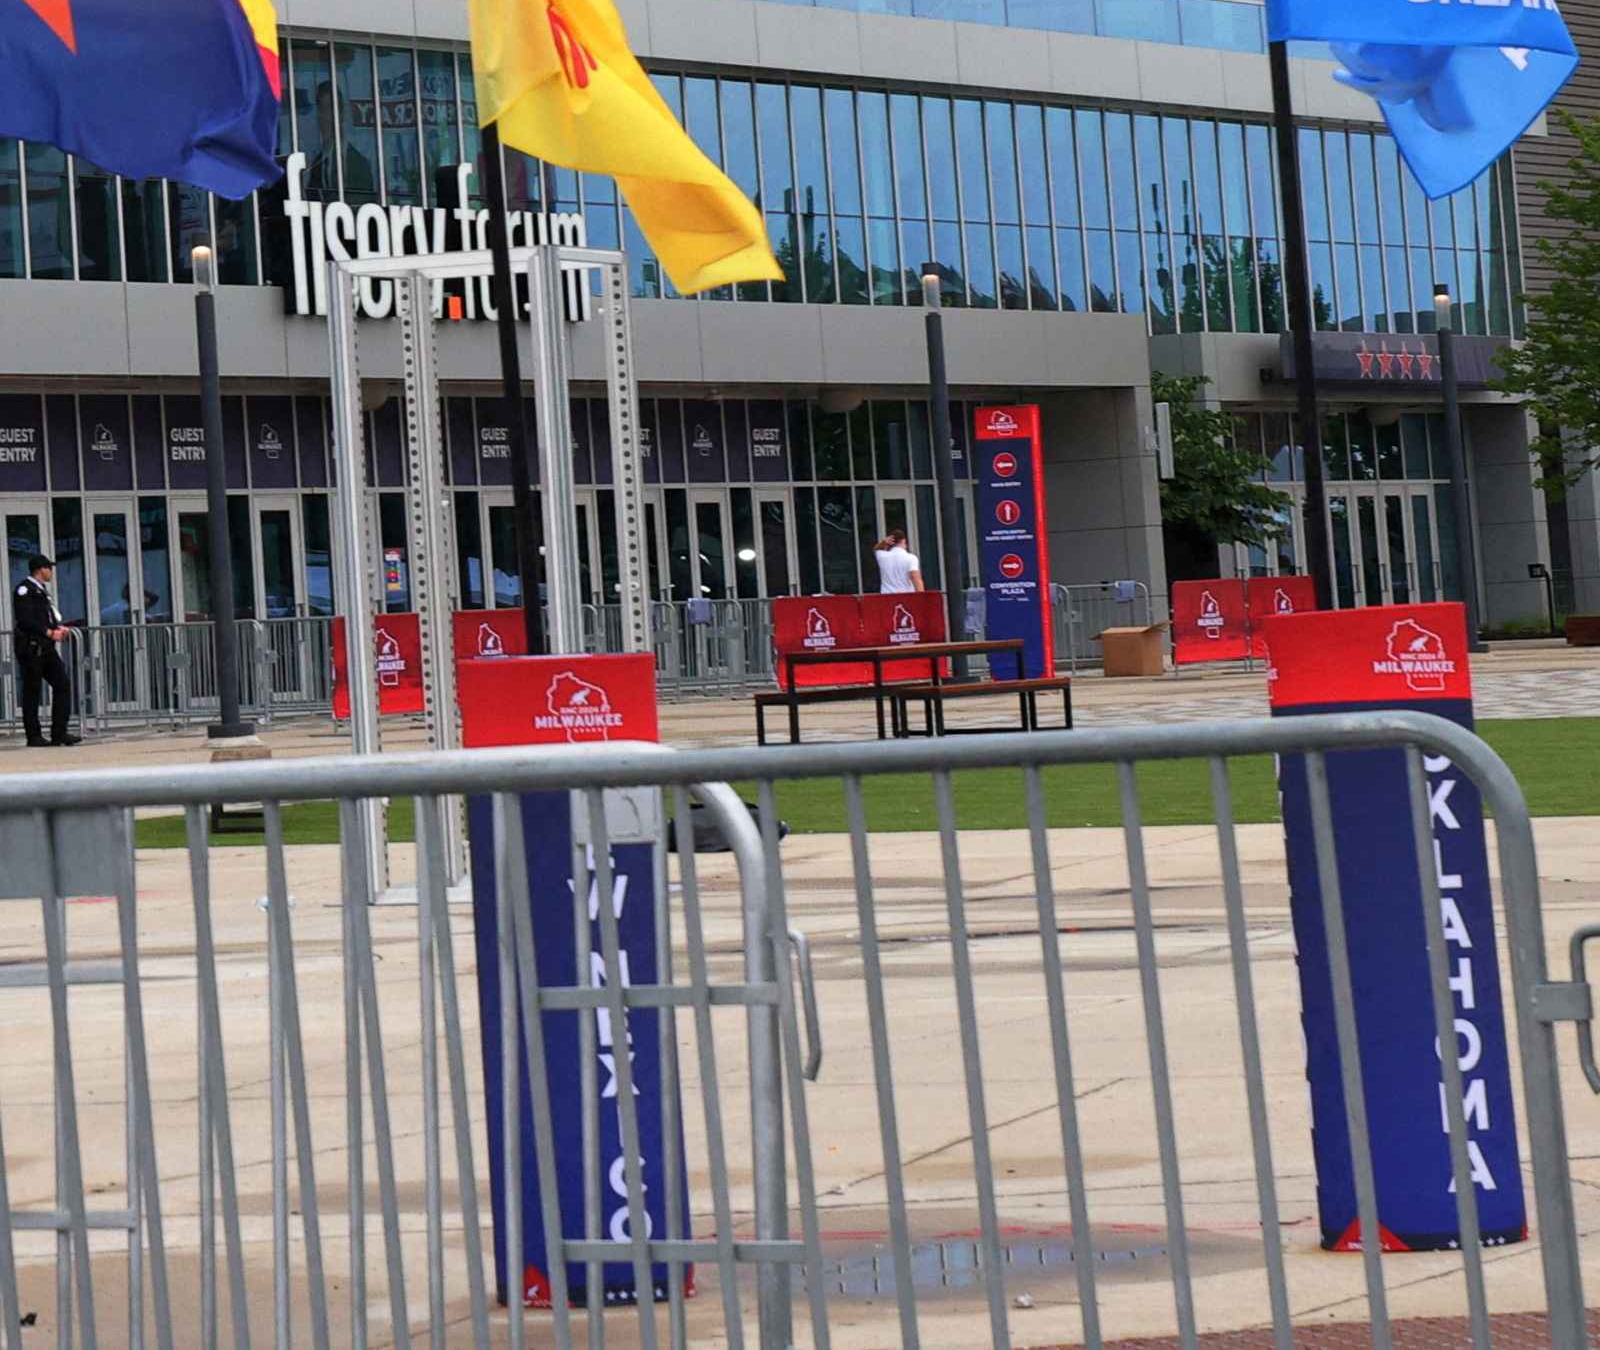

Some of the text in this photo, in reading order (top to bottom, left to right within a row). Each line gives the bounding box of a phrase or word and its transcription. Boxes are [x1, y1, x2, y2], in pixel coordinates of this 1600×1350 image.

[170, 428, 205, 442] GUEST
[481, 427, 509, 441] GUES
[752, 428, 780, 441] GUEST
[754, 445, 782, 457] ENTRY
[1373, 660, 1456, 673] MILWAUKEE
[535, 713, 623, 729] MILWAUKEE
